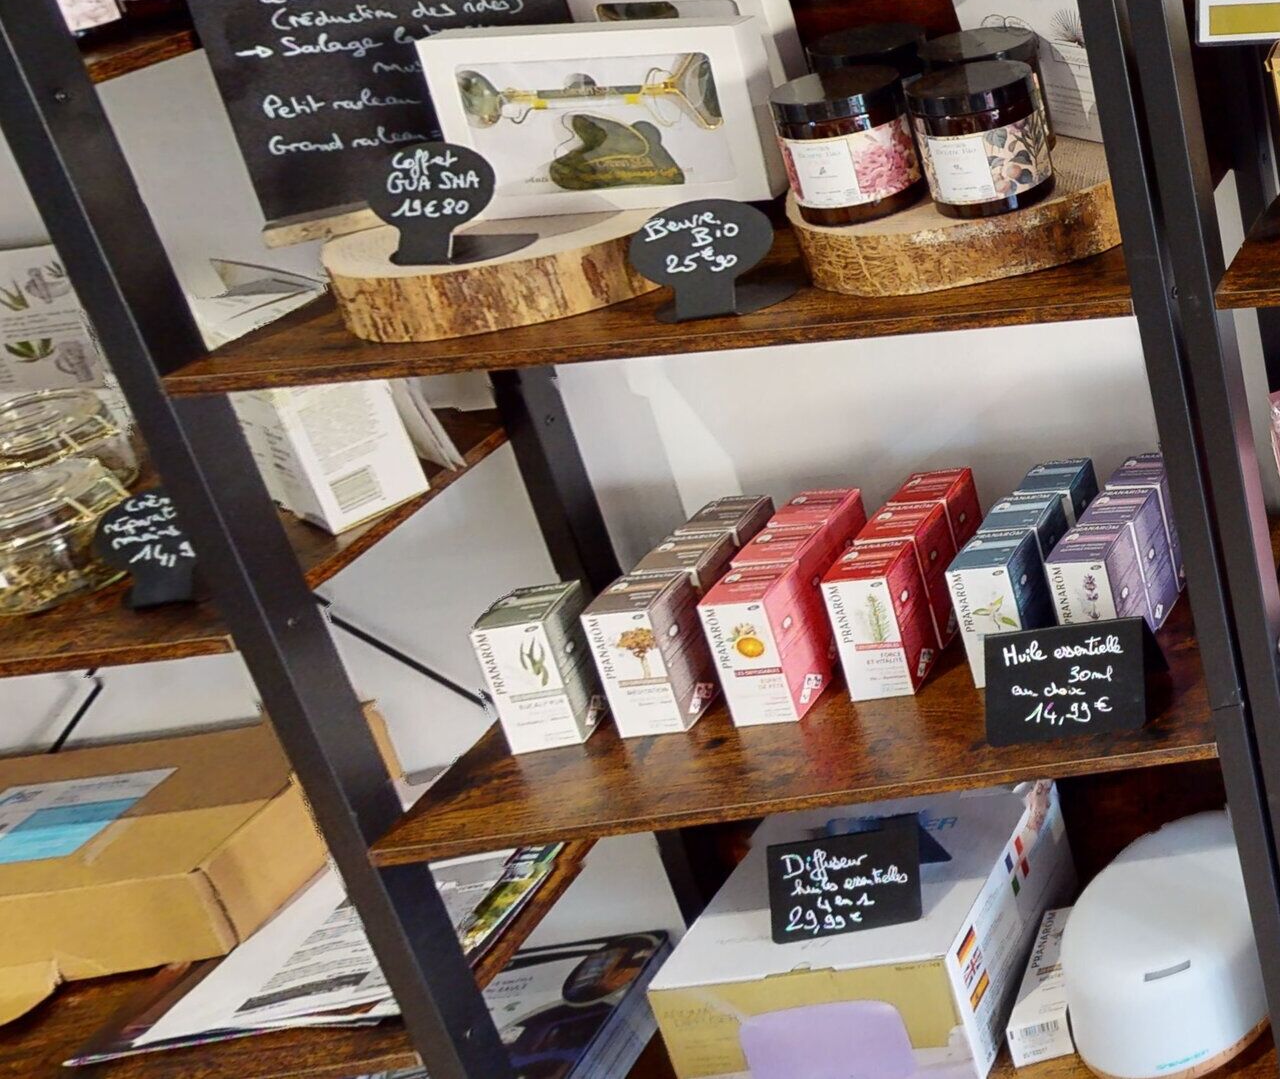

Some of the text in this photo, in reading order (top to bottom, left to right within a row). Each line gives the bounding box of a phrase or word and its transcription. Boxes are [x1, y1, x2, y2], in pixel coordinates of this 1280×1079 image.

[263, 94, 325, 119] Petit
[269, 133, 345, 155] Grand
[387, 171, 481, 193] GUA SHA
[1003, 634, 1124, 667] Huile essentielle
[1068, 668, 1113, 683] 30ml
[781, 848, 868, 880] Diffuseur
